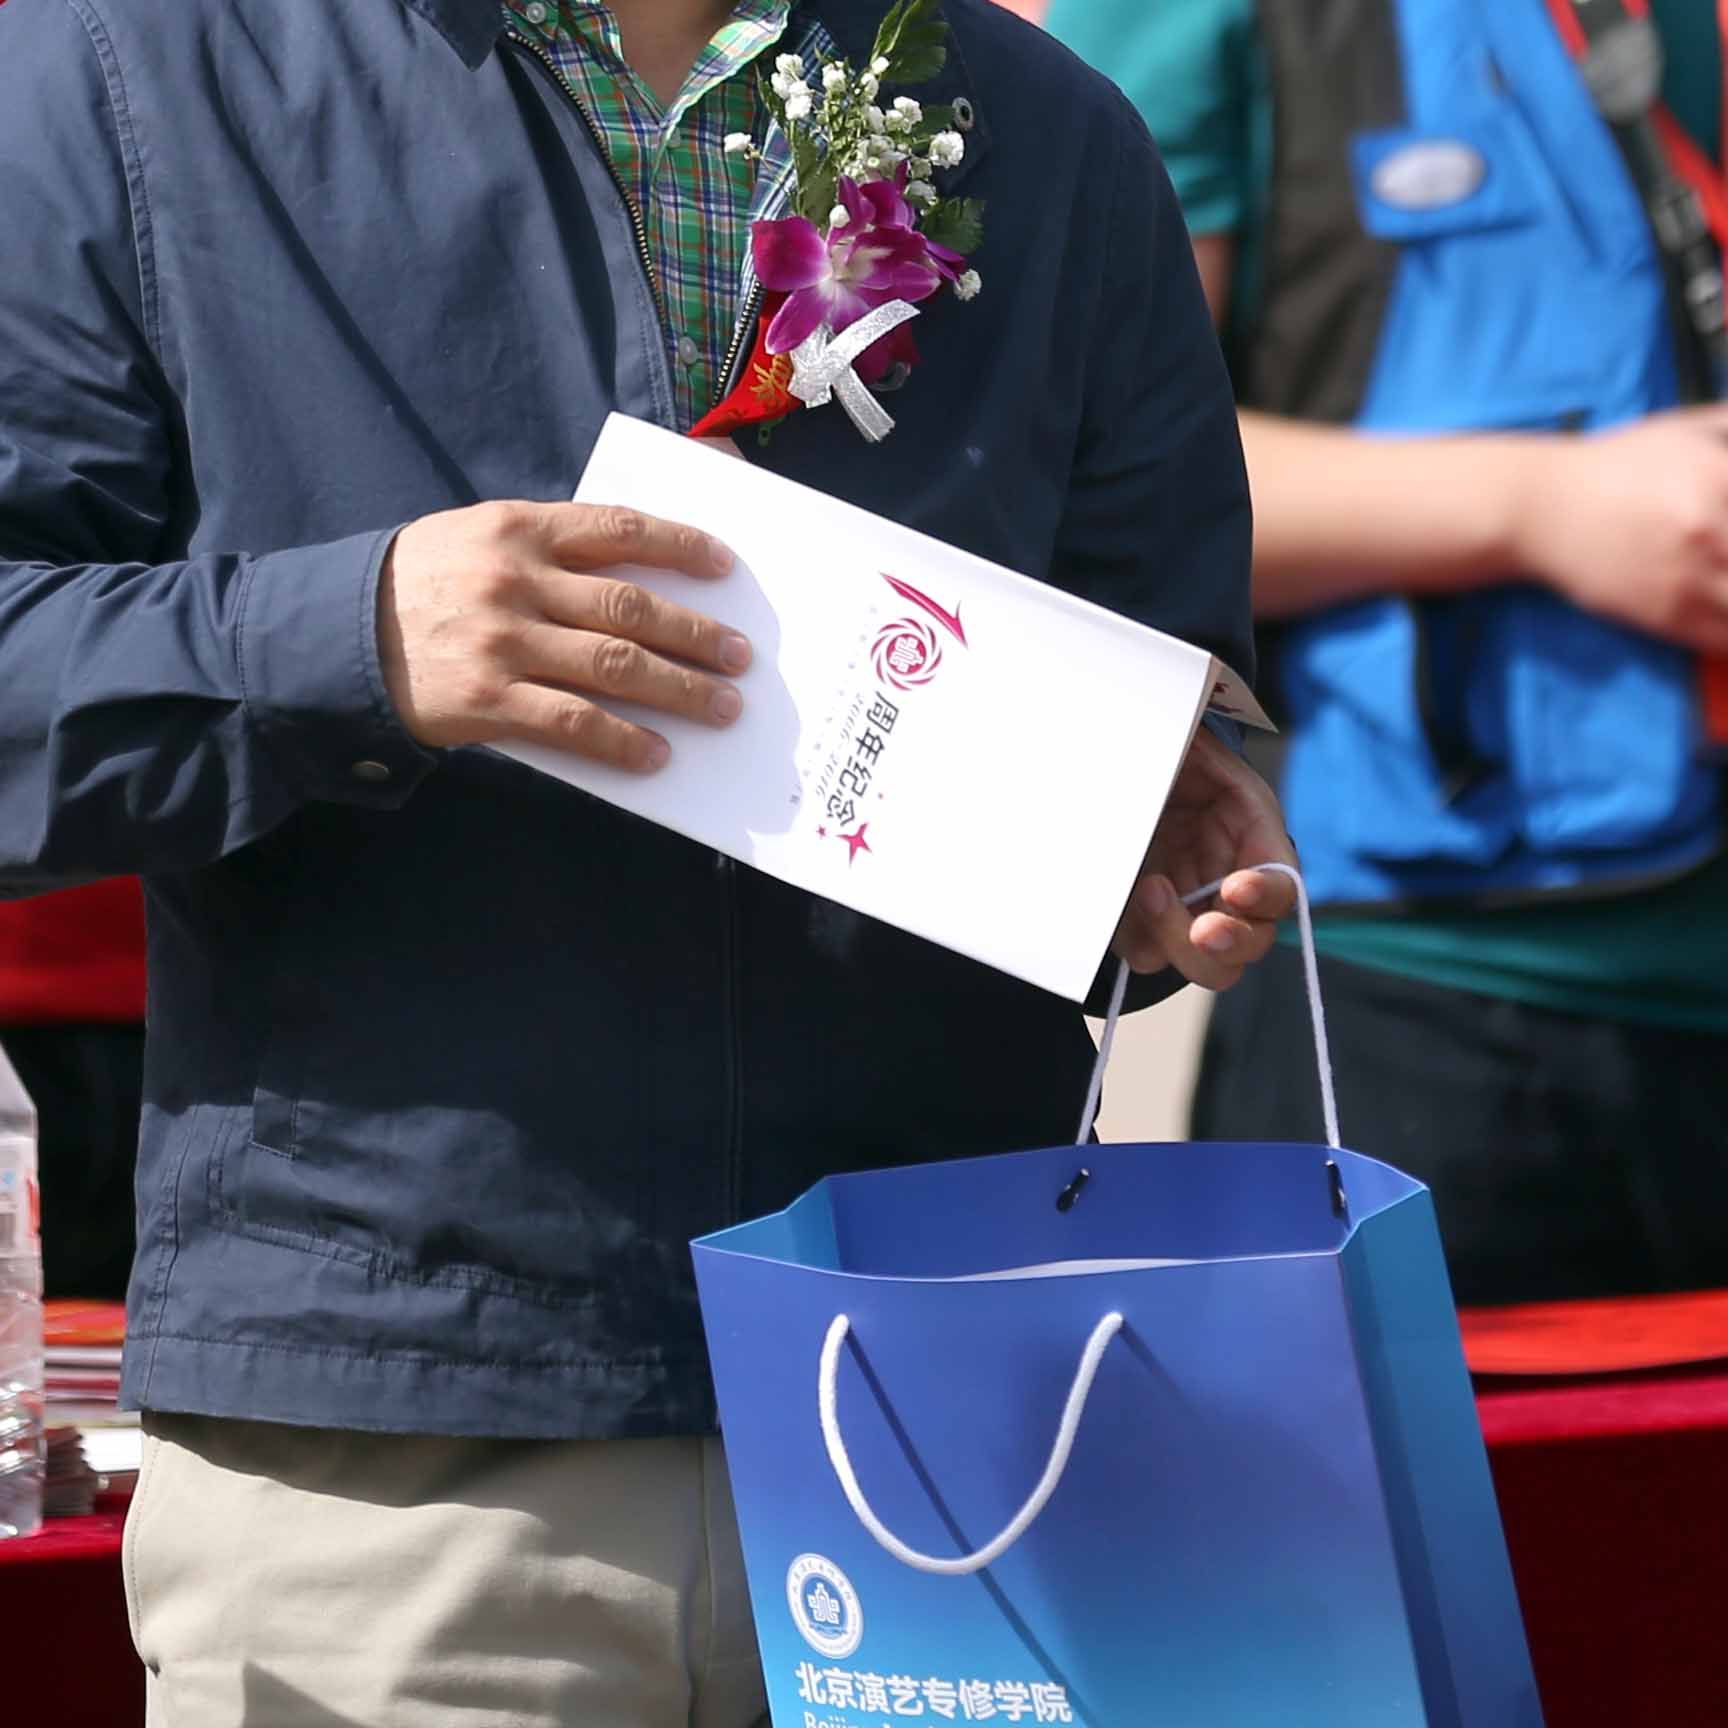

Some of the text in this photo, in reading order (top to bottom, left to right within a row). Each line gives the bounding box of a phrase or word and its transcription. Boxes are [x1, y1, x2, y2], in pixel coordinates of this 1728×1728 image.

[825, 690, 900, 828] 周年纪念
[794, 1659, 1073, 1724] 北京演艺专修学院
